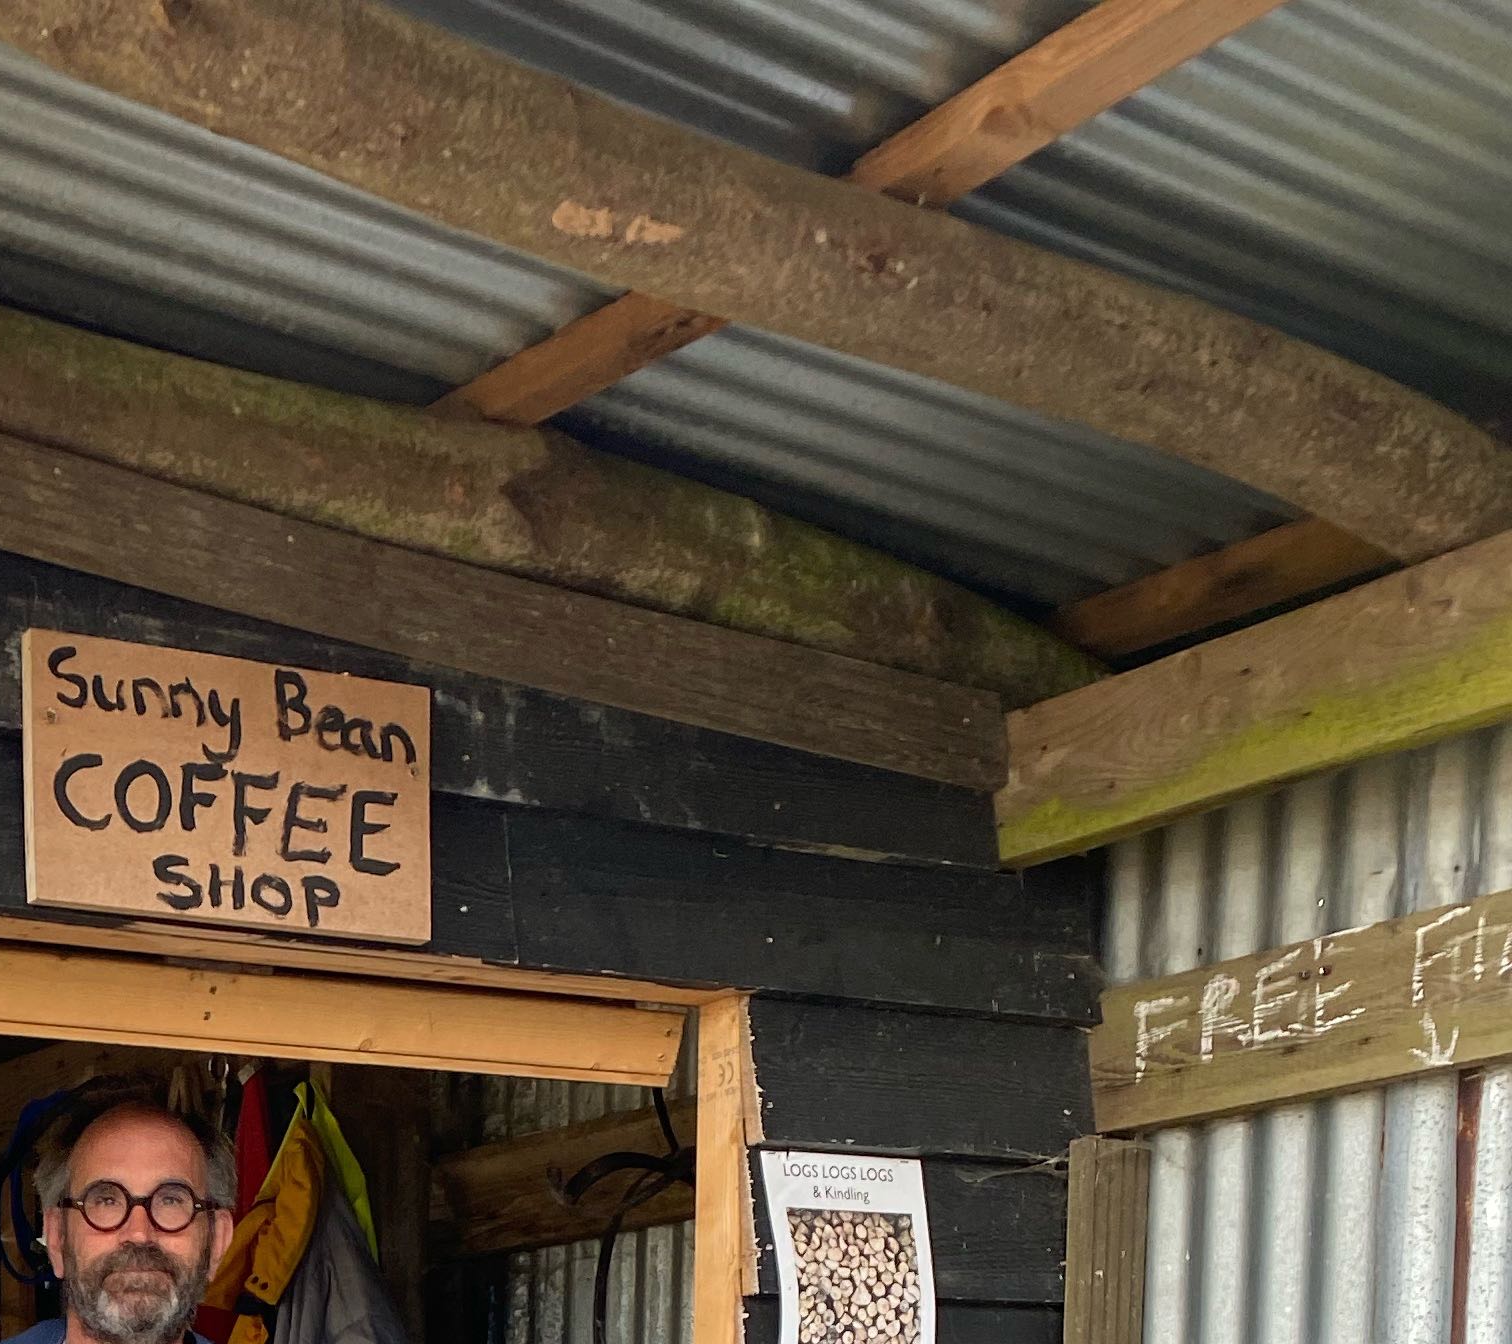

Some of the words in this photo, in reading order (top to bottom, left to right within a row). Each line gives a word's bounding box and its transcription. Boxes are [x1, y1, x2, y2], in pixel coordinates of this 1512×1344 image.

[47, 646, 242, 763] Sunny
[275, 669, 417, 764] Bean
[54, 753, 401, 876] COFFEE
[152, 854, 340, 928] SHOP
[783, 1163, 818, 1178] LOGS
[822, 1165, 857, 1180] LOGS
[860, 1167, 894, 1182] LOGS
[813, 1186, 821, 1198] &
[825, 1186, 870, 1204] Kindling
